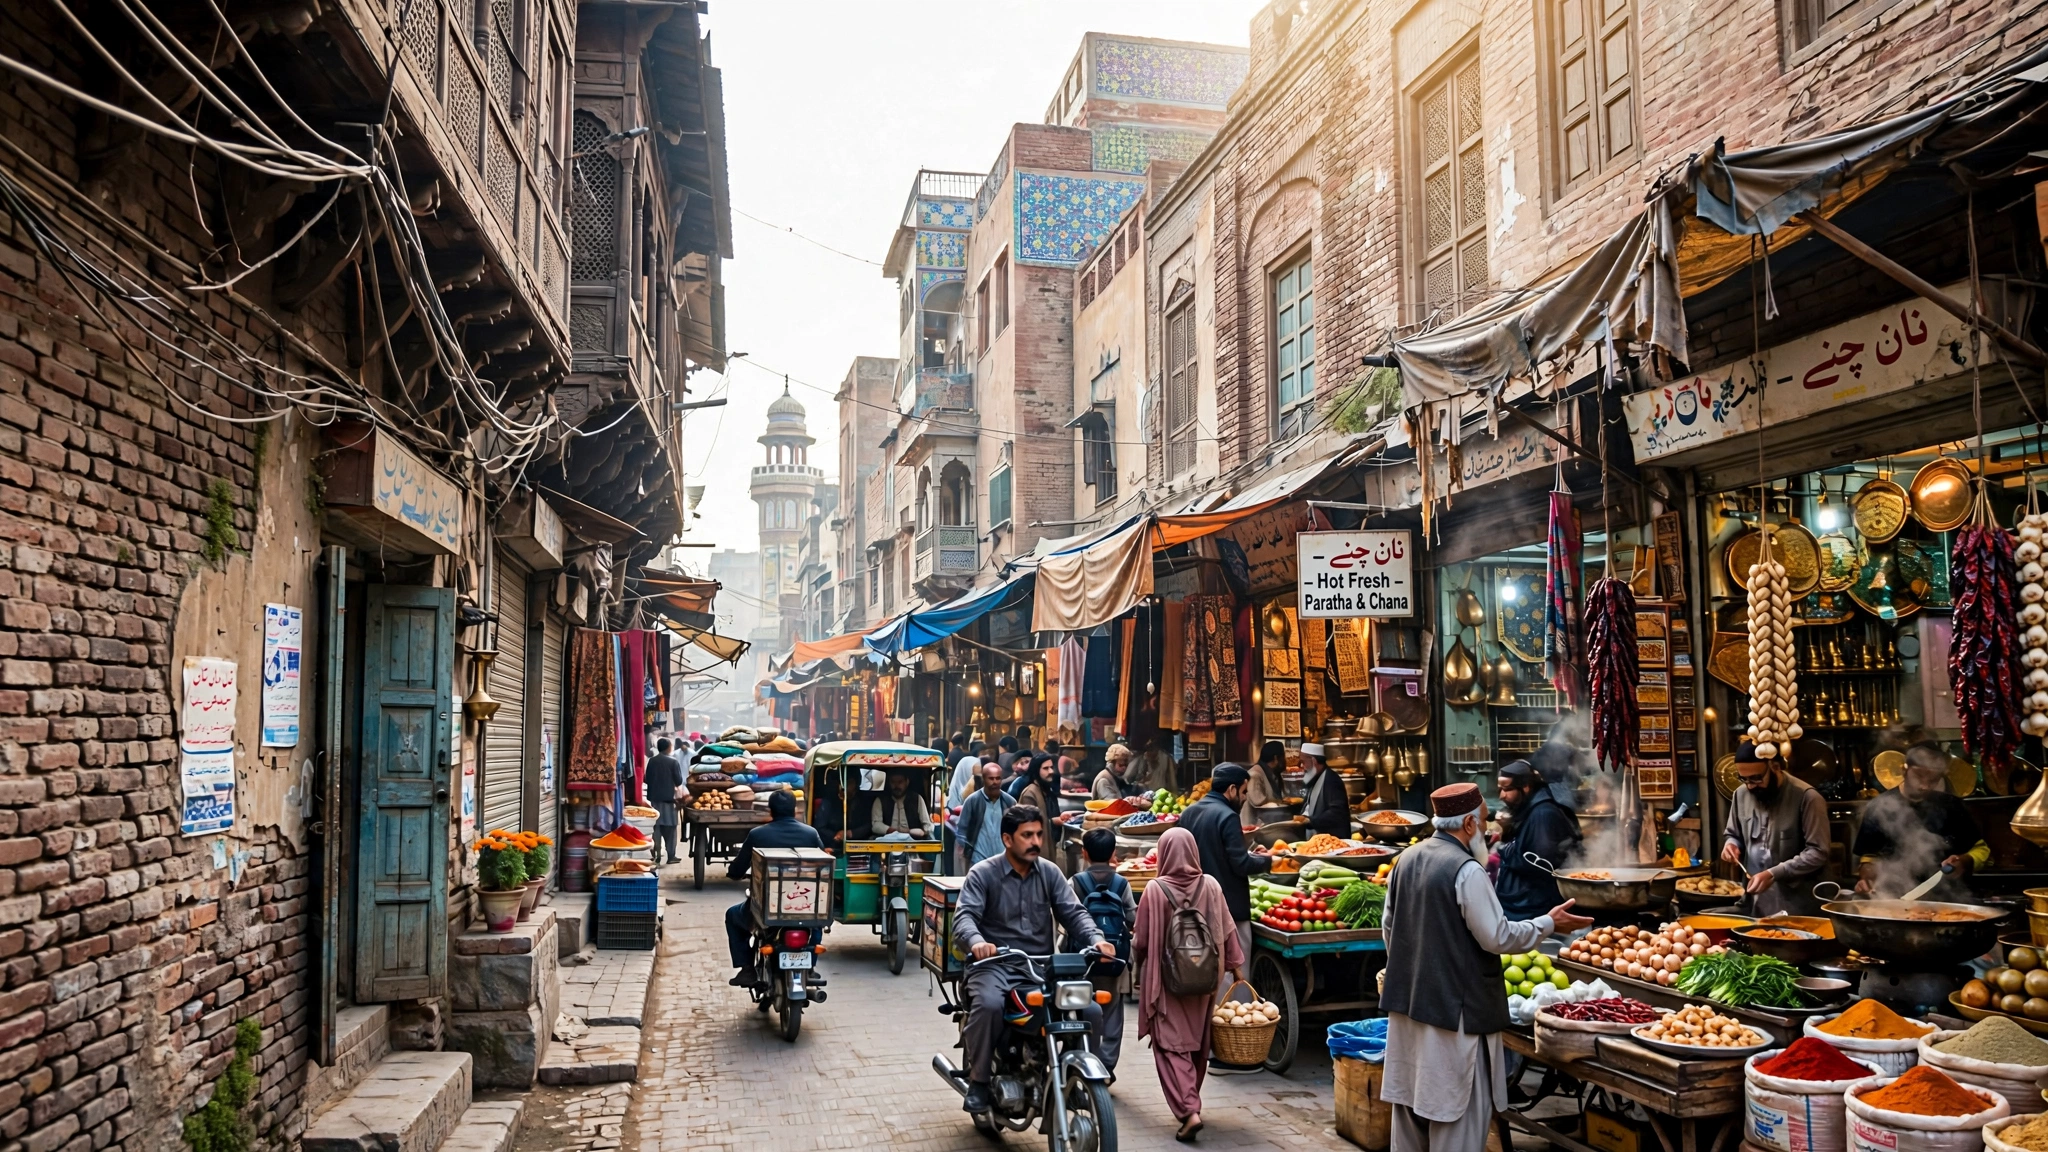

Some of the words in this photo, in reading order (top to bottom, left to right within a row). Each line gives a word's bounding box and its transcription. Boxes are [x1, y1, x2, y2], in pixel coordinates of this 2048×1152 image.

[1875, 308, 1928, 366] نان
[1803, 340, 1865, 389] چنے
[1329, 541, 1371, 569] چنے
[1374, 537, 1404, 565] نان
[1317, 572, 1344, 589] Hot
[1348, 572, 1390, 588] Fresh
[1305, 594, 1352, 611] Paratha
[1356, 593, 1366, 610] &
[1369, 592, 1408, 609] Chana
